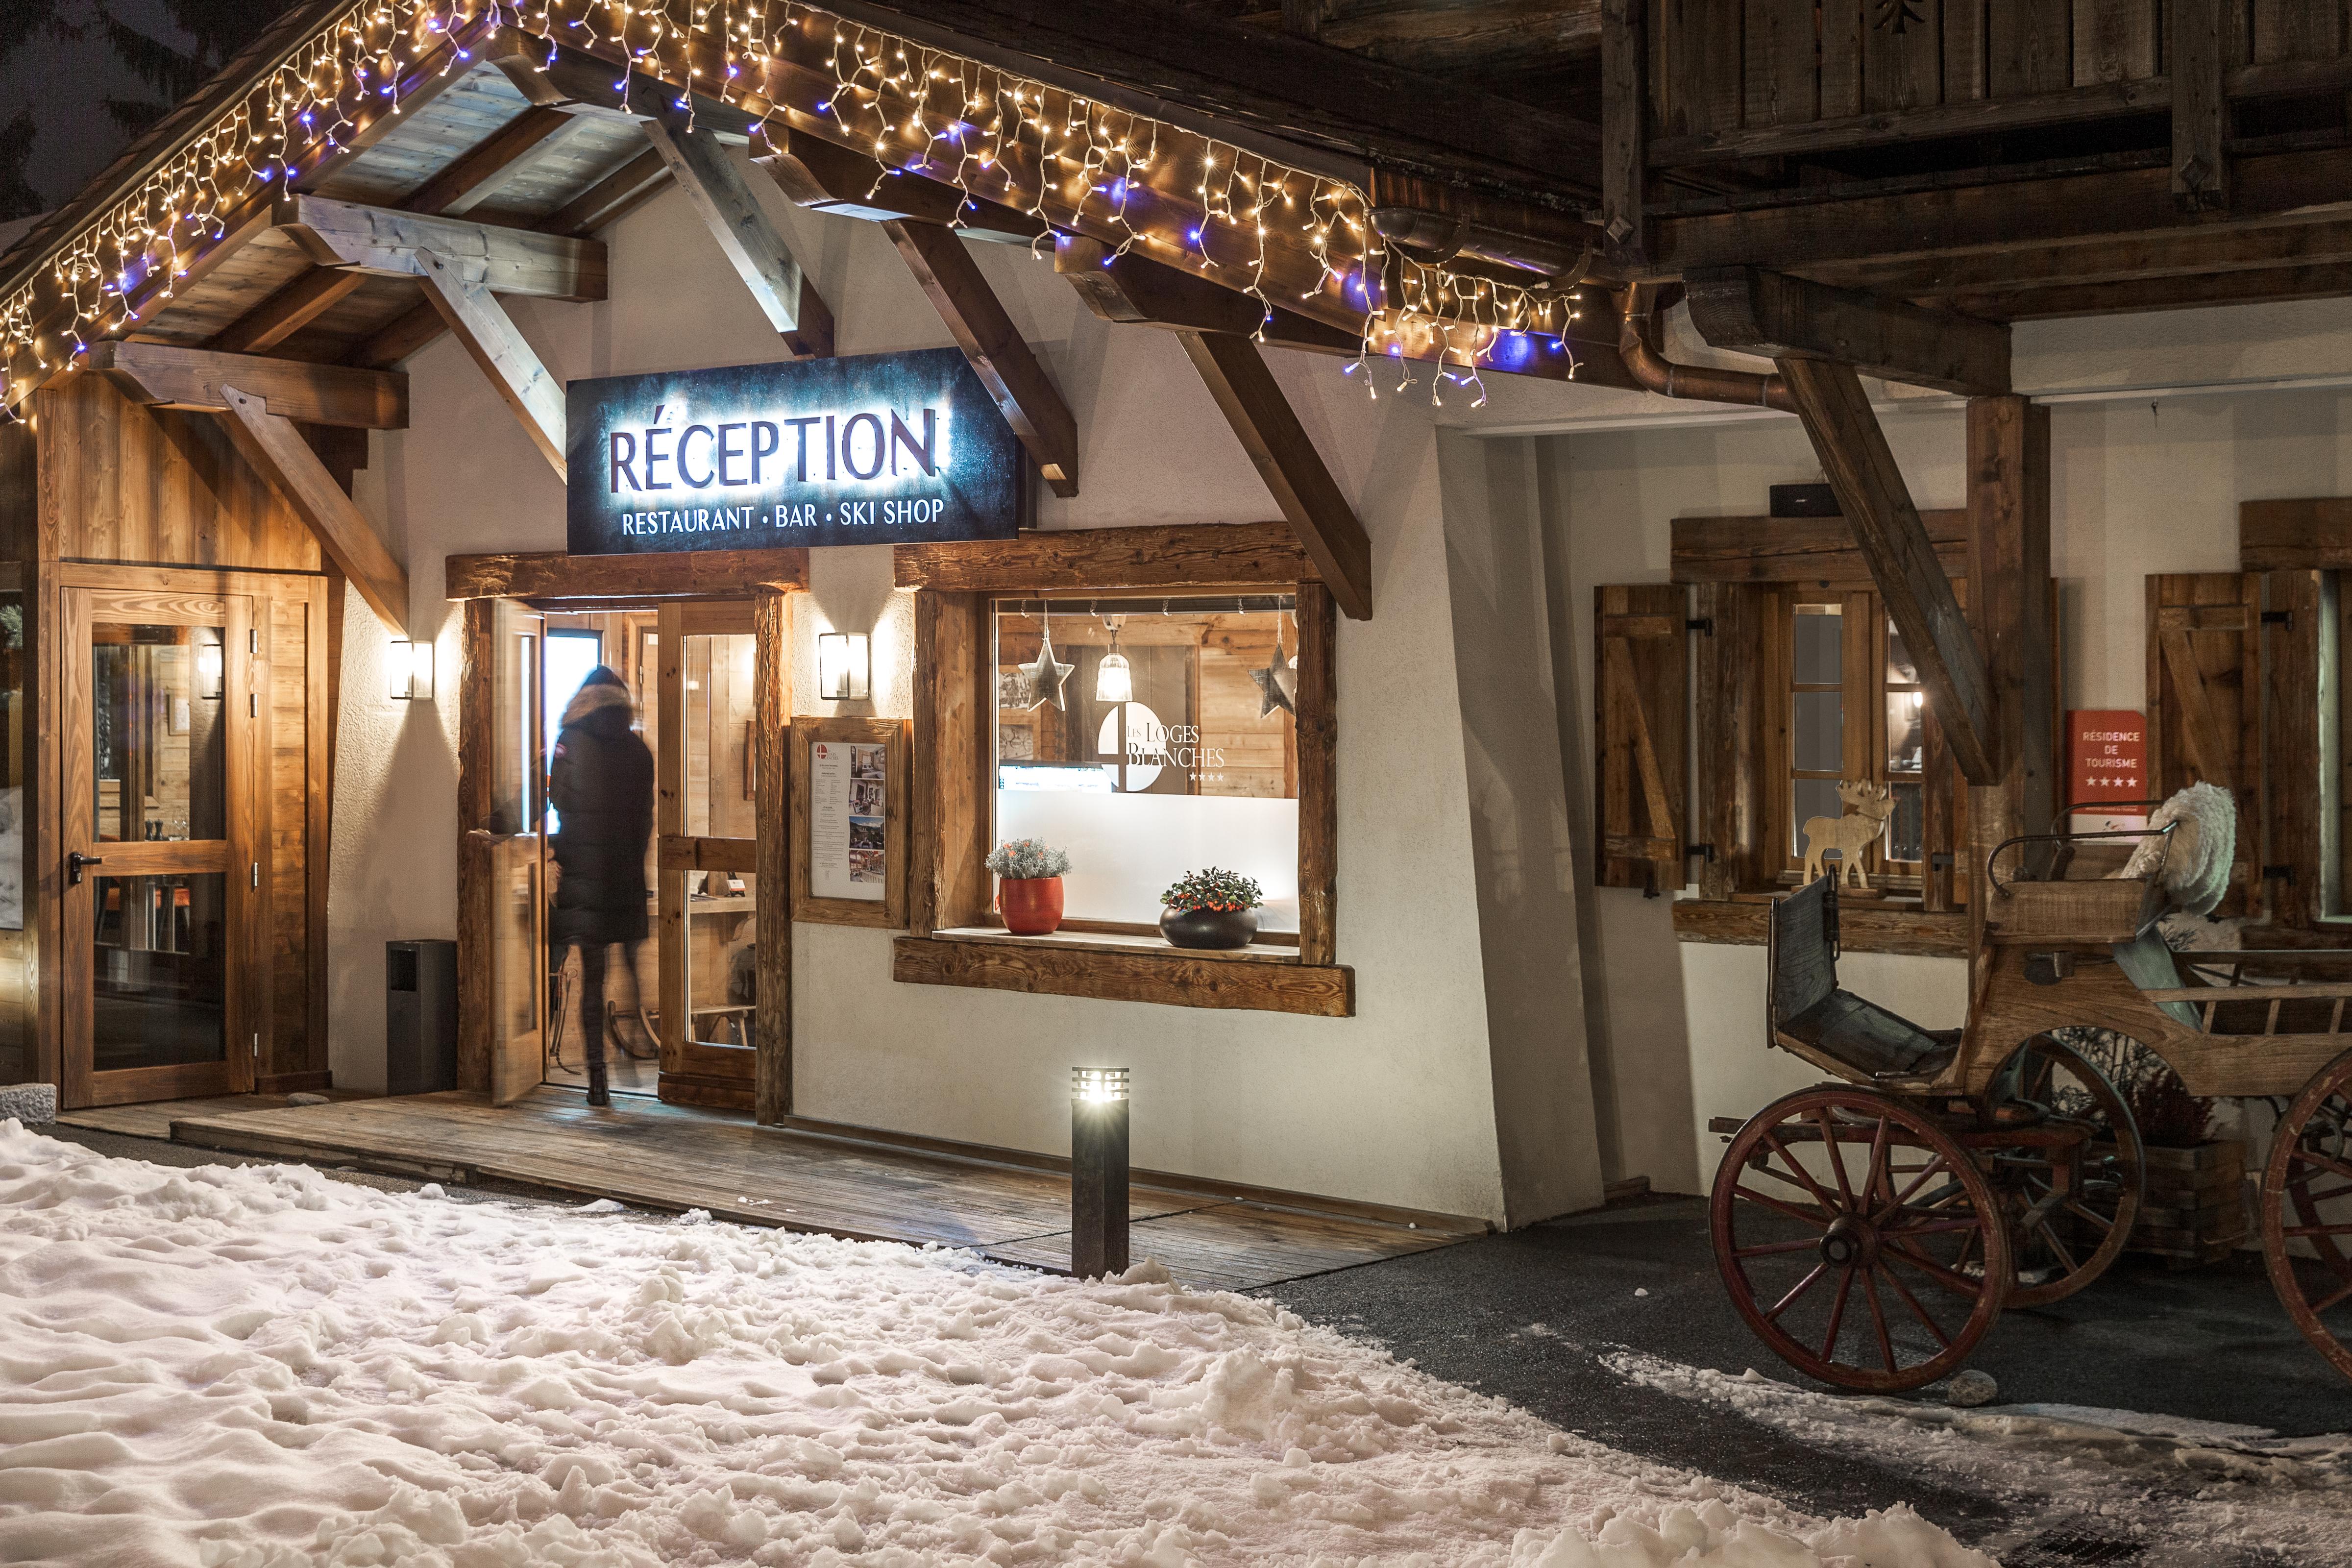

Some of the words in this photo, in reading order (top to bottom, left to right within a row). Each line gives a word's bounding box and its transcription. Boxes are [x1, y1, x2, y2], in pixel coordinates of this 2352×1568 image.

[611, 405, 936, 493] RÉCEPTION
[623, 506, 755, 535] RESTAURANT
[776, 504, 817, 528] BAR
[840, 501, 875, 525] SKI
[883, 499, 945, 523] SHOP
[1146, 722, 1200, 743] LOGES
[2082, 730, 2141, 742] RÉSIDENCE
[1128, 742, 1225, 768] BLANCHES
[2104, 744, 2119, 755] DE
[2084, 758, 2138, 769] TOURISME
